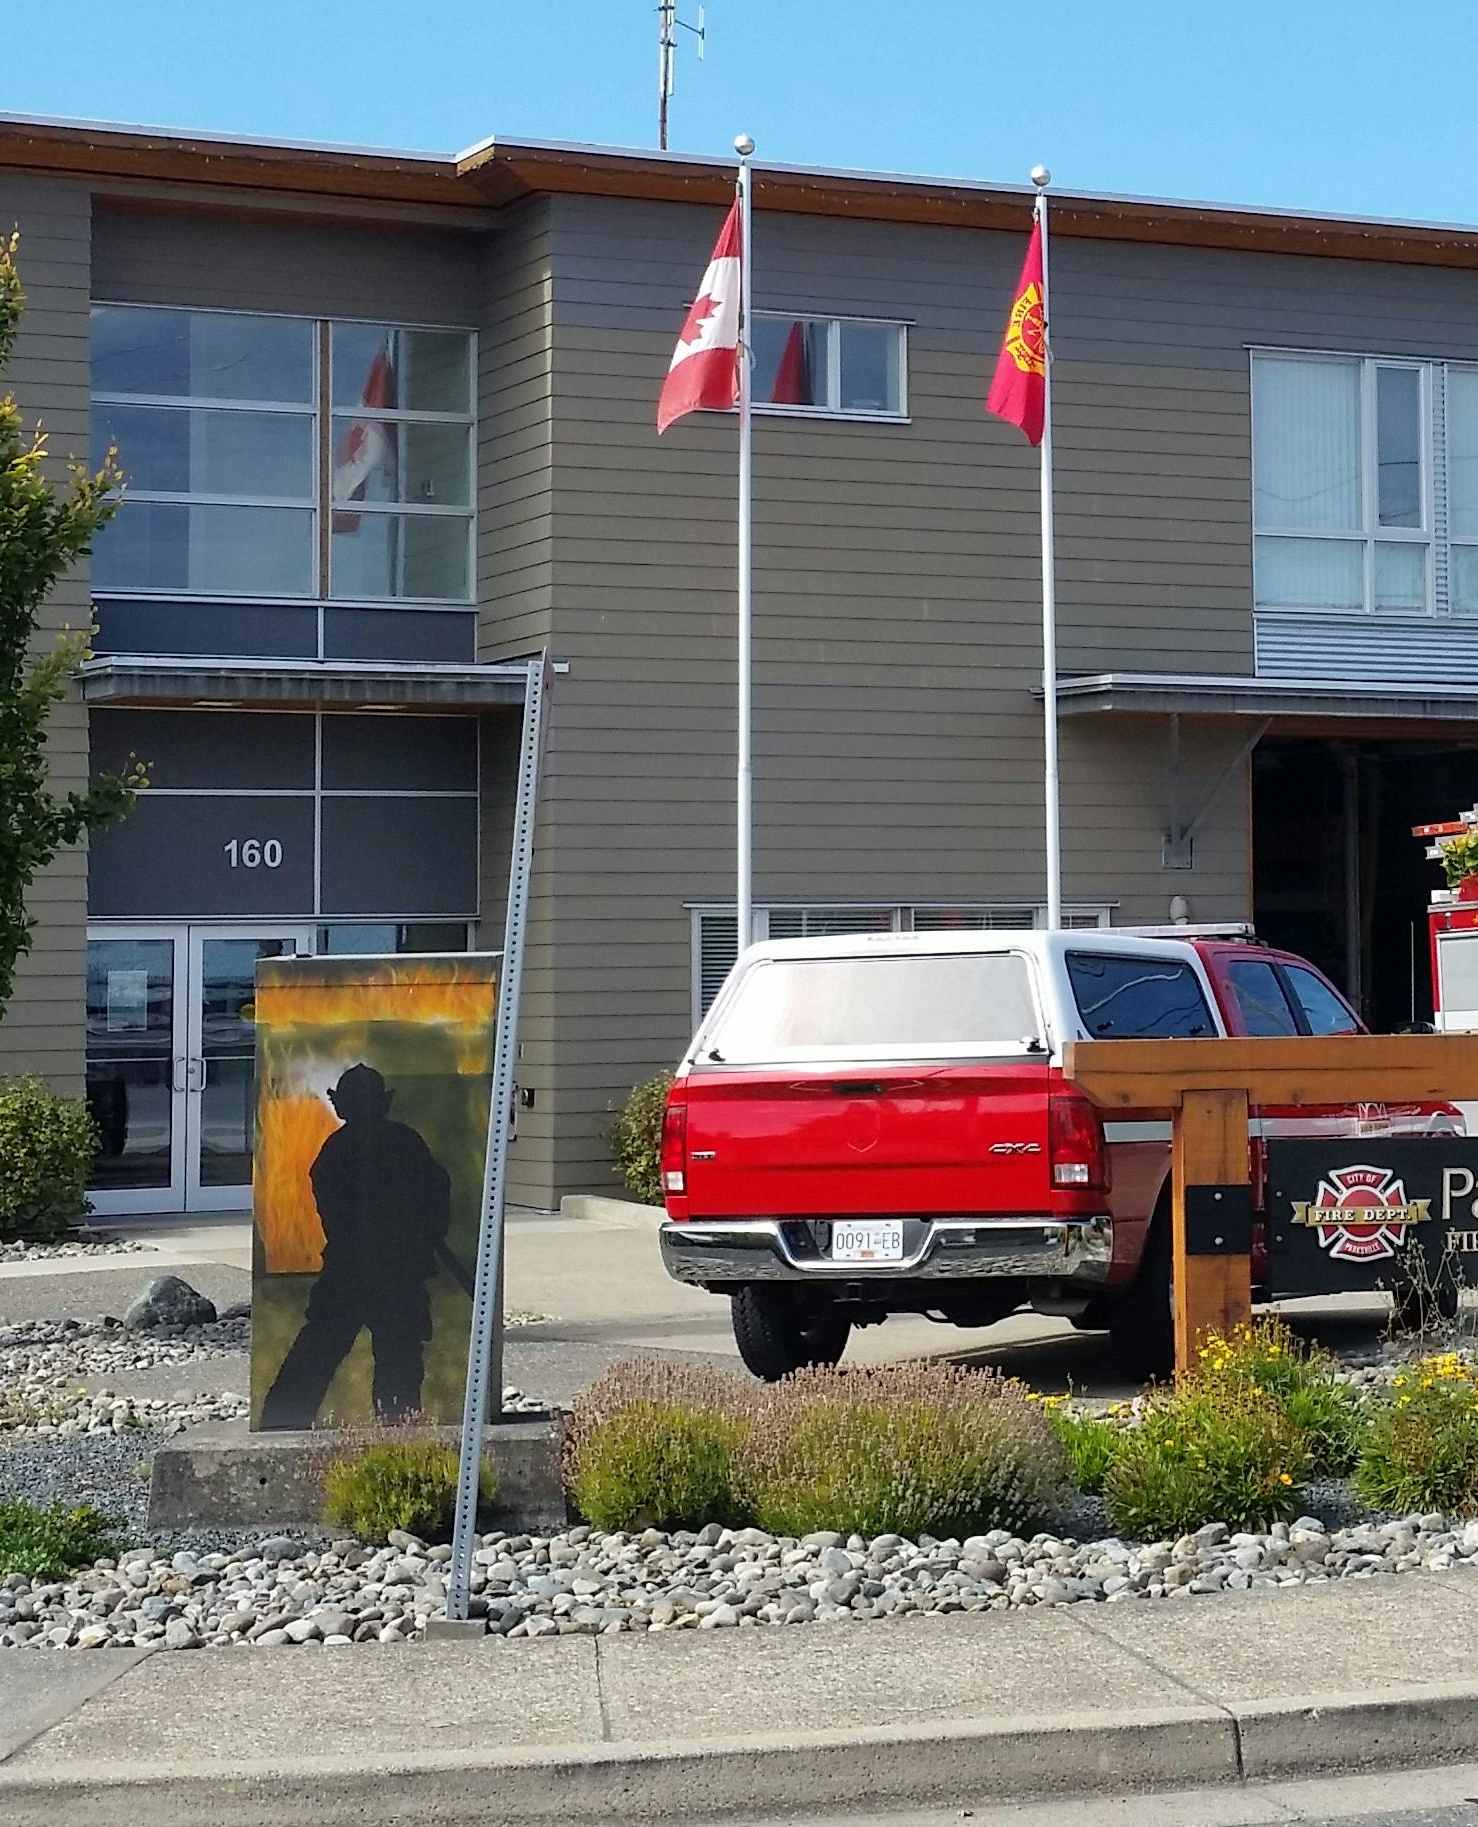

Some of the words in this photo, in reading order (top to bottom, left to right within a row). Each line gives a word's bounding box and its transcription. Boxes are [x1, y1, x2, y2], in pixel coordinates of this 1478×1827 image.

[224, 839, 283, 868] 160
[1346, 1173, 1363, 1185] CITY
[1365, 1173, 1377, 1183] OF
[1315, 1209, 1354, 1221] FIRE
[1363, 1208, 1412, 1221] DEPT.
